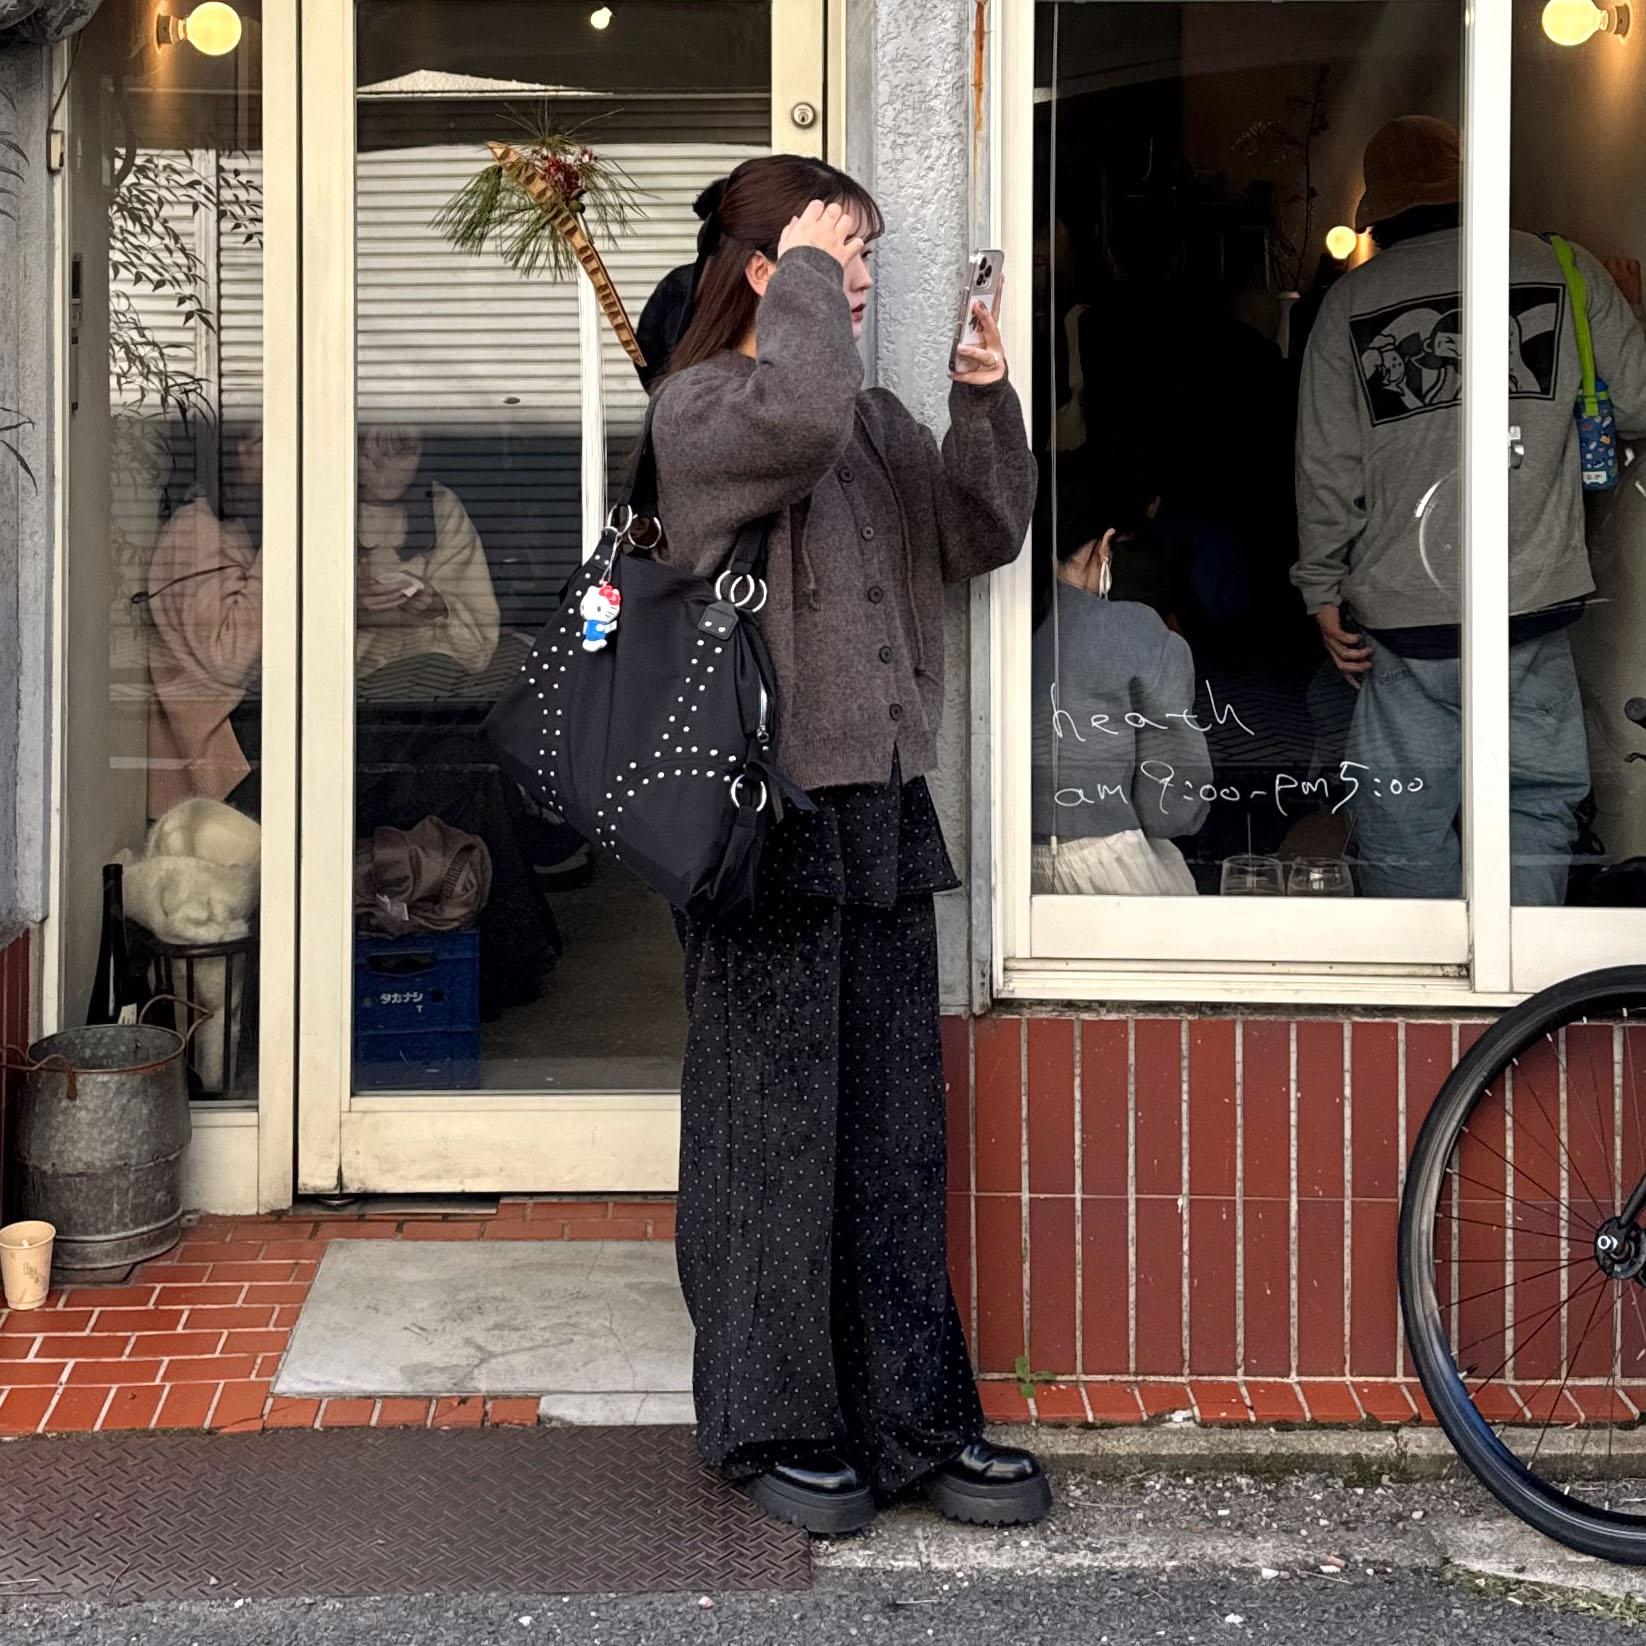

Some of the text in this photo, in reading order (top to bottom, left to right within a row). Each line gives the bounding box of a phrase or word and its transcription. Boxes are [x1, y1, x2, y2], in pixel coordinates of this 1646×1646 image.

[1050, 680, 1255, 742] heath
[1055, 782, 1129, 806] am
[380, 992, 424, 1004] タカナシ
